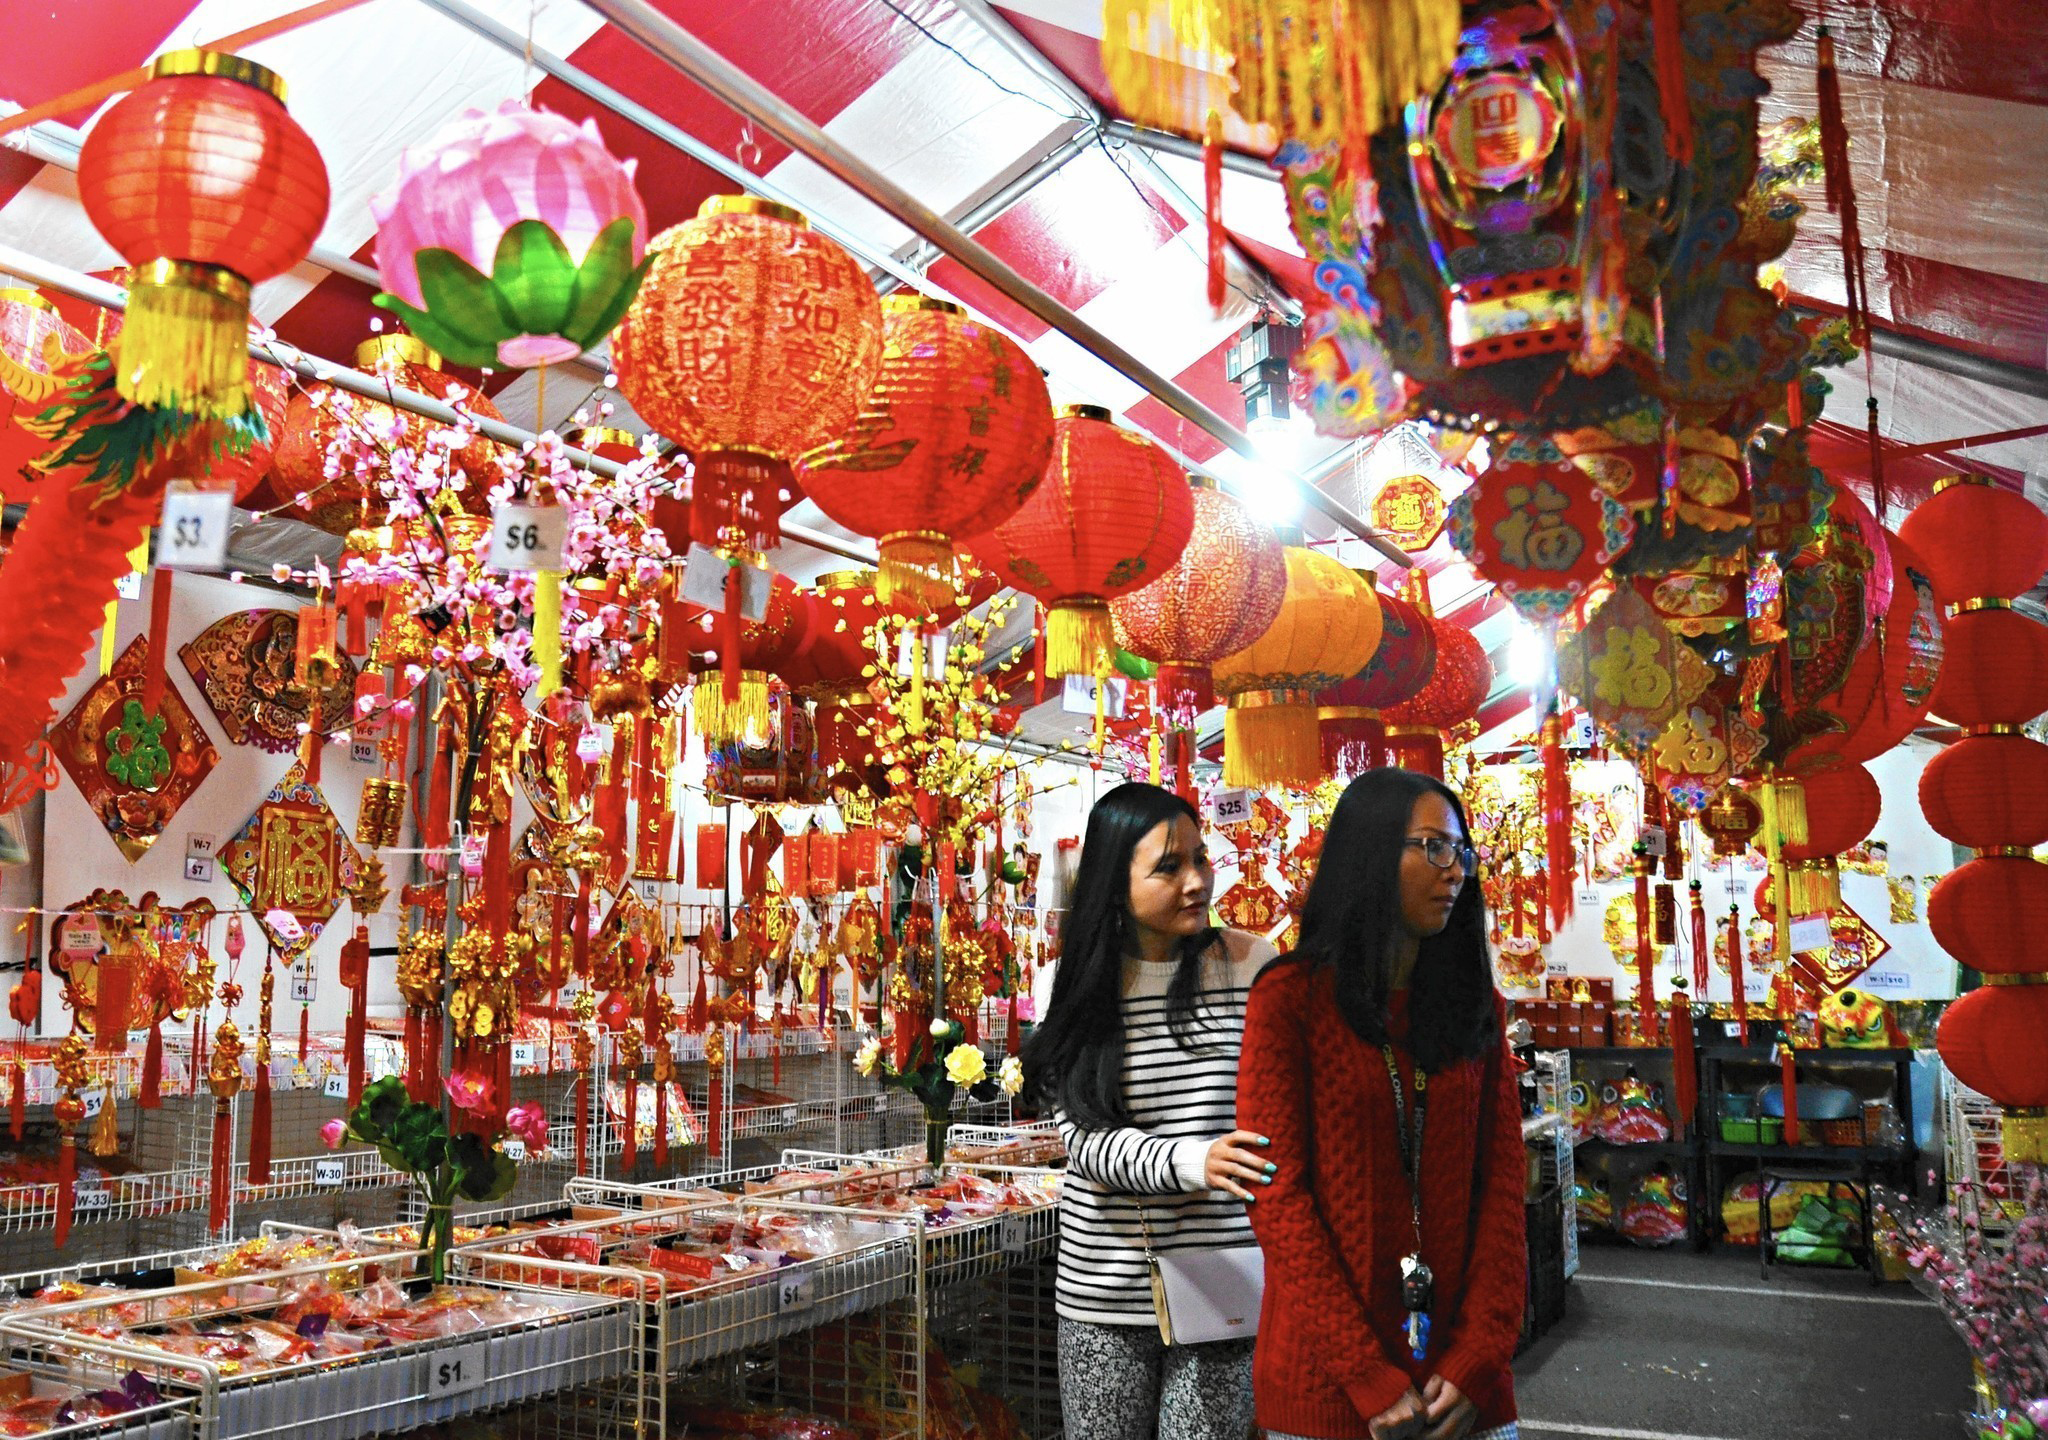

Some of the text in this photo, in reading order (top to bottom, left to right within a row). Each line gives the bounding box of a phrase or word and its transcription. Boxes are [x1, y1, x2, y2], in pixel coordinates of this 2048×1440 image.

[174, 516, 201, 547] $3
[1493, 480, 1584, 571] 福
[506, 525, 537, 551] $6
[1589, 625, 1672, 709] 福
[1653, 706, 1728, 774] 福
[355, 745, 370, 755] $10
[1218, 800, 1242, 816] $25
[193, 839, 211, 850] W-7
[262, 816, 329, 907] 福
[192, 864, 203, 876] $7
[296, 965, 314, 973] W-1
[297, 985, 308, 995] $6
[515, 1049, 525, 1059] $2
[329, 1081, 341, 1091] $1
[87, 1097, 101, 1111] $1
[316, 1169, 341, 1179] W-30
[77, 1194, 108, 1207] W-33
[784, 1285, 798, 1304] $1
[438, 1360, 461, 1388] $1
